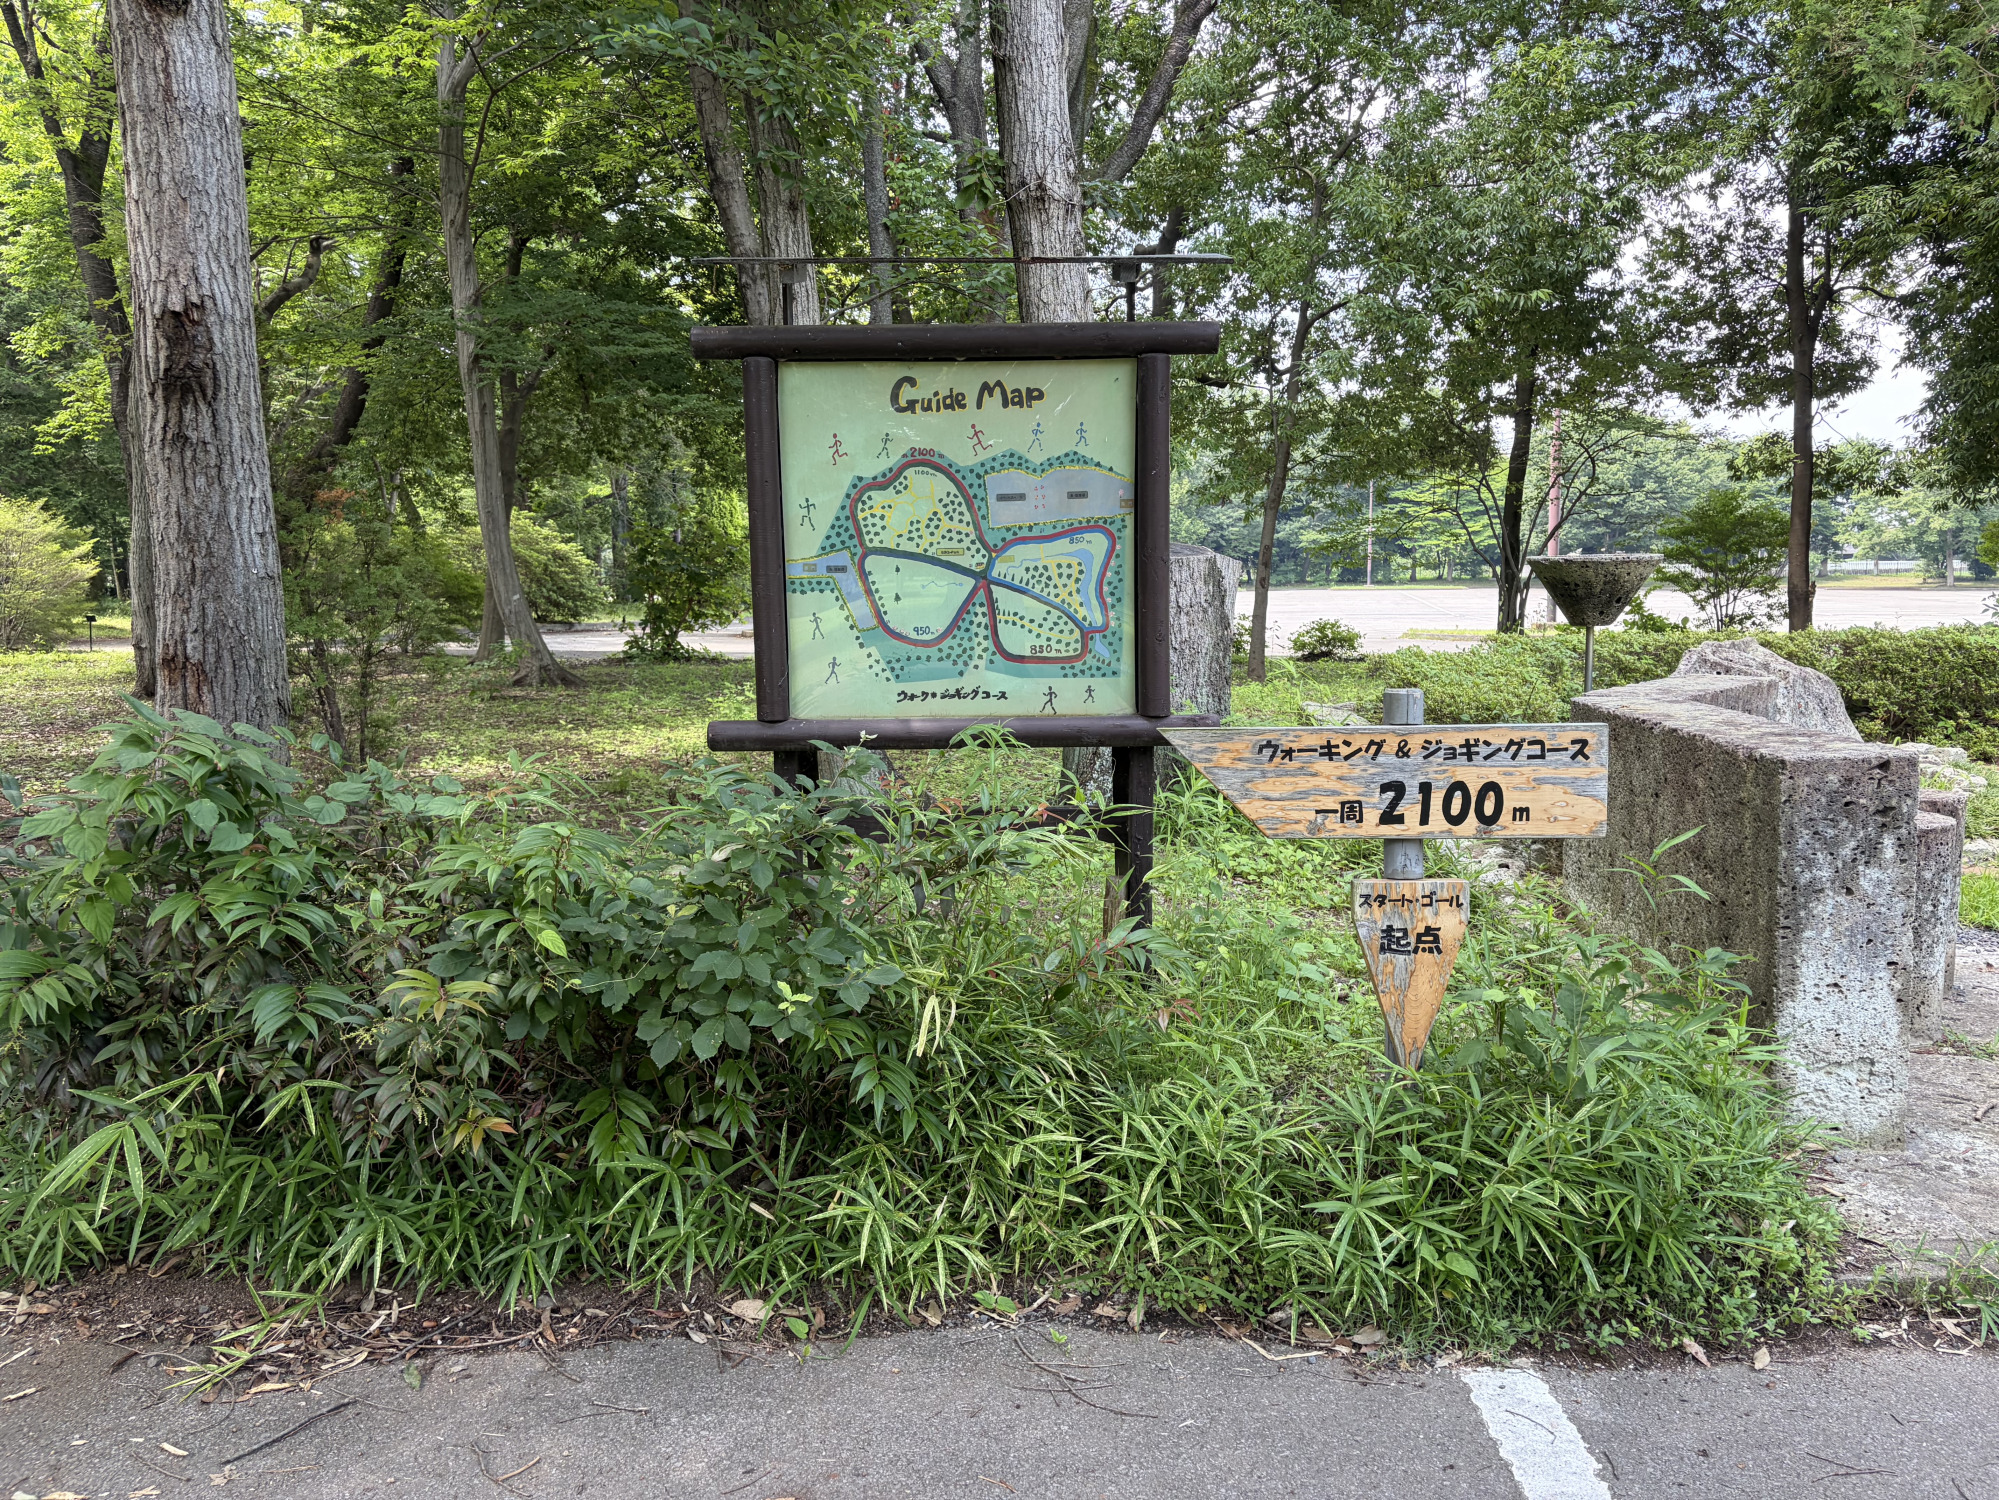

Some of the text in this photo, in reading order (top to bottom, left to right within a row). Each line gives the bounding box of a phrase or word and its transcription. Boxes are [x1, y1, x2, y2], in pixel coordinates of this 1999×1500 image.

[889, 375, 1046, 414] Guide Map
[910, 447, 935, 458] 2100
[1068, 536, 1085, 545] 850
[913, 626, 931, 636] 950
[1029, 644, 1053, 655] 850
[1257, 737, 1591, 762] ウォーキング & ジョギングコース
[1315, 780, 1530, 826] 一周 2100 m
[1379, 924, 1443, 956] 起点
